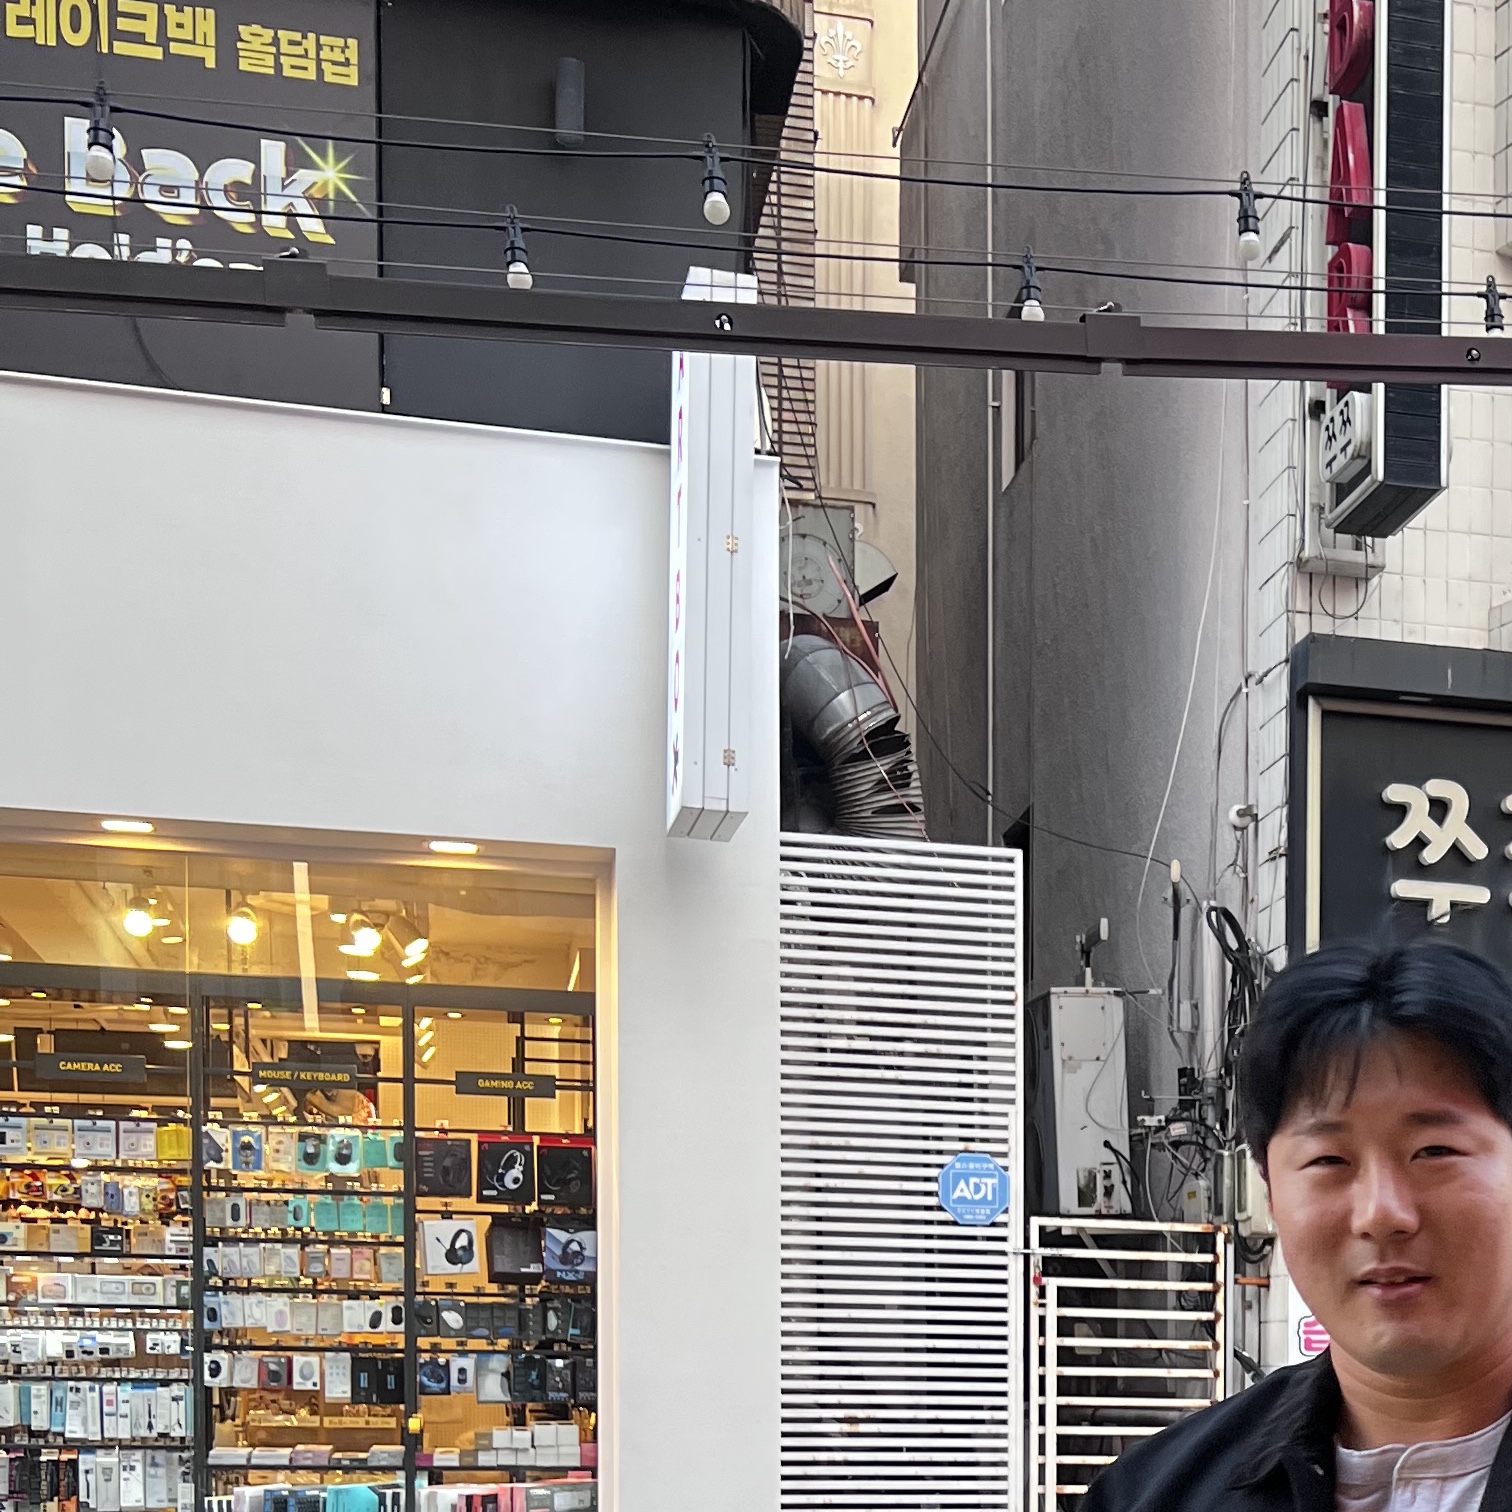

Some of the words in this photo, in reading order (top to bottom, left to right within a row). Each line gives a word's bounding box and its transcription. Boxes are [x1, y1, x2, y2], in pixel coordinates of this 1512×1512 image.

[5, 0, 216, 68] 레이크백
[236, 24, 358, 85] 홀덤펍
[59, 1061, 100, 1072] CAMERA
[103, 1063, 122, 1073] ACC
[259, 1070, 291, 1079] MOUSE
[300, 1071, 350, 1082] KEYBOARD
[515, 1080, 534, 1090] ACC
[952, 1177, 998, 1200] ADT
